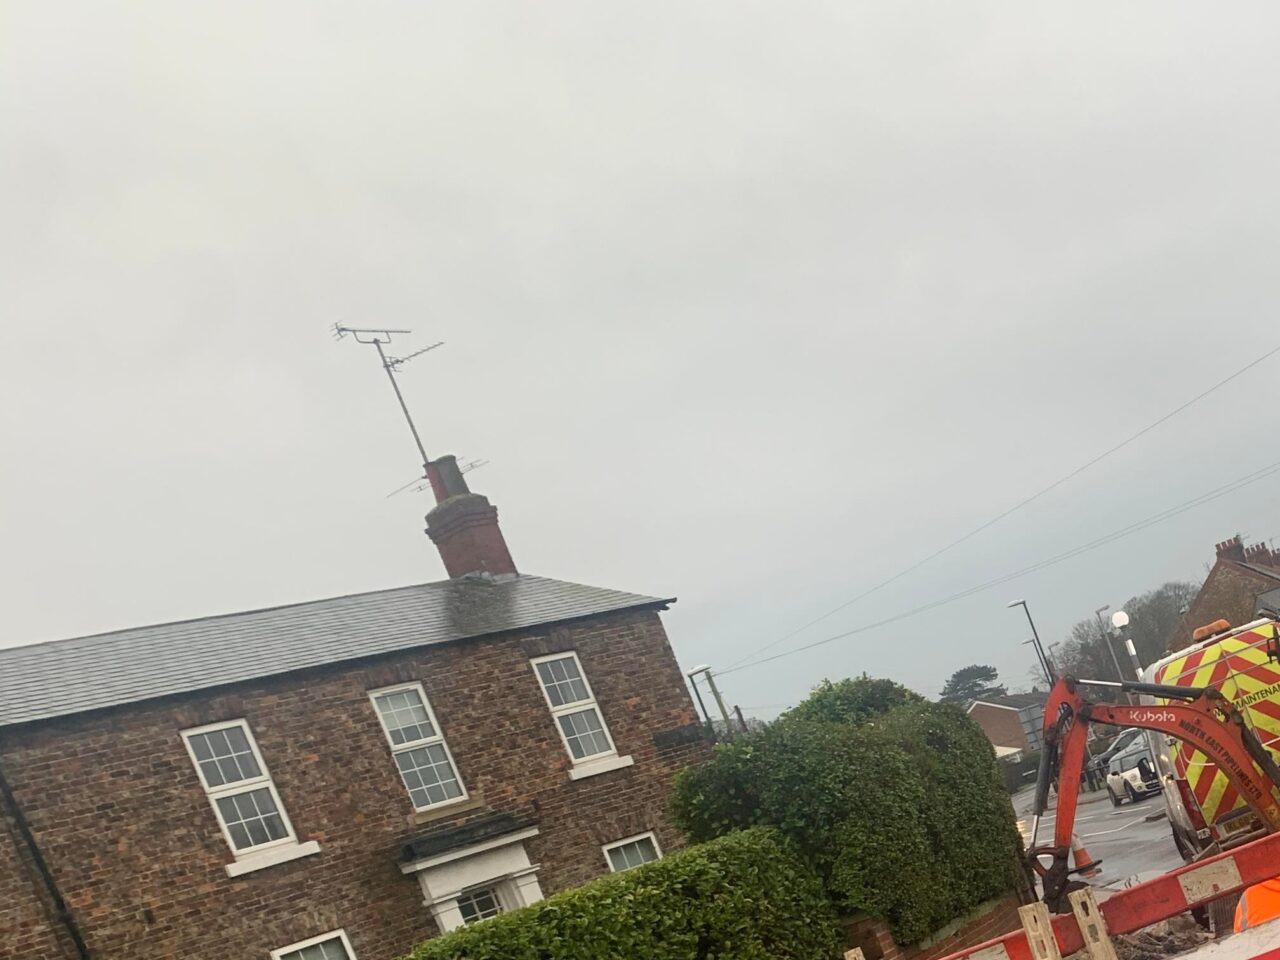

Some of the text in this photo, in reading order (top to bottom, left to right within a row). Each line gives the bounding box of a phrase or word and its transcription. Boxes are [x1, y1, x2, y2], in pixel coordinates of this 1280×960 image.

[1130, 711, 1175, 721] Kubota
[1179, 719, 1263, 800] NORTH EAST PIPELINES LTD
